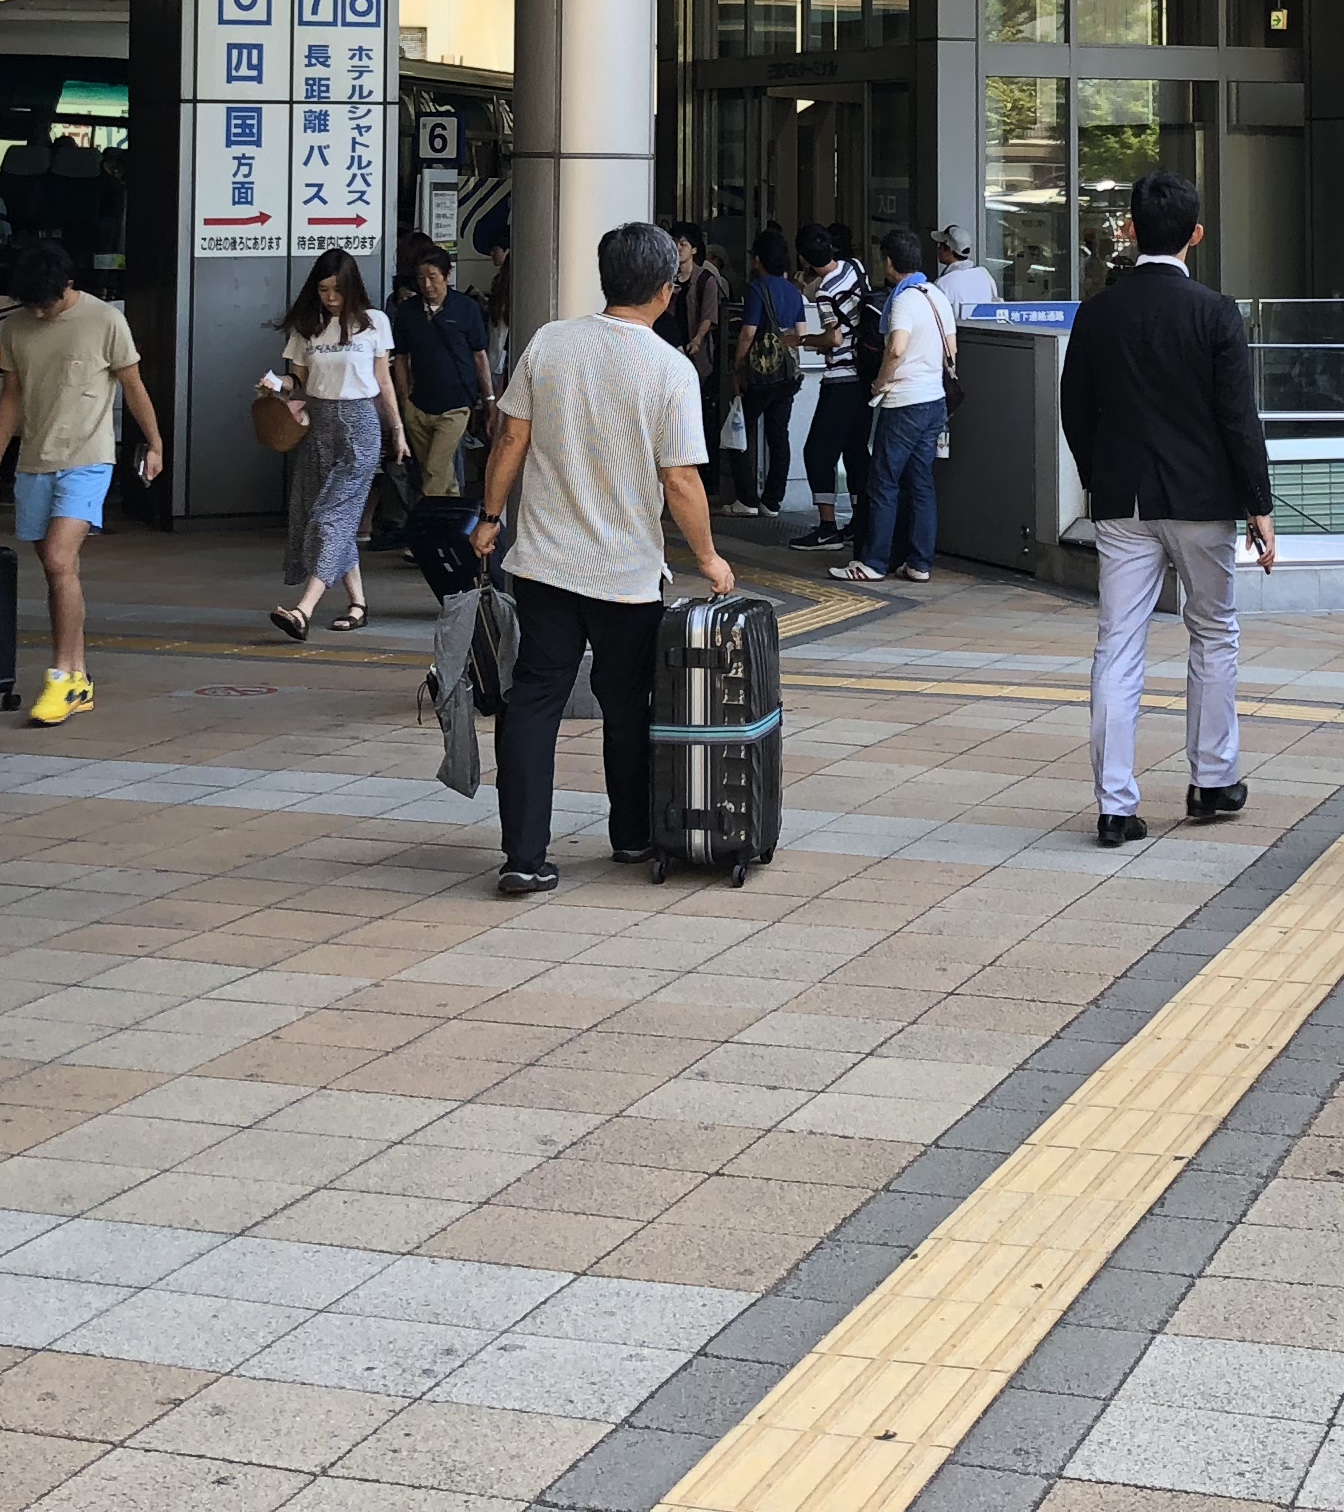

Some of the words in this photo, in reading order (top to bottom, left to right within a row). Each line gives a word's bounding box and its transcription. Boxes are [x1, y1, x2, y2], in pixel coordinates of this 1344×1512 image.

[225, 43, 264, 207] 四国方面
[302, 44, 332, 206] 長距離バス
[345, 44, 375, 206] ホテルシャトルバス
[428, 122, 448, 154] 6
[200, 236, 282, 251] この柱の後ろにあります
[296, 236, 377, 251] 待合室内にあります
